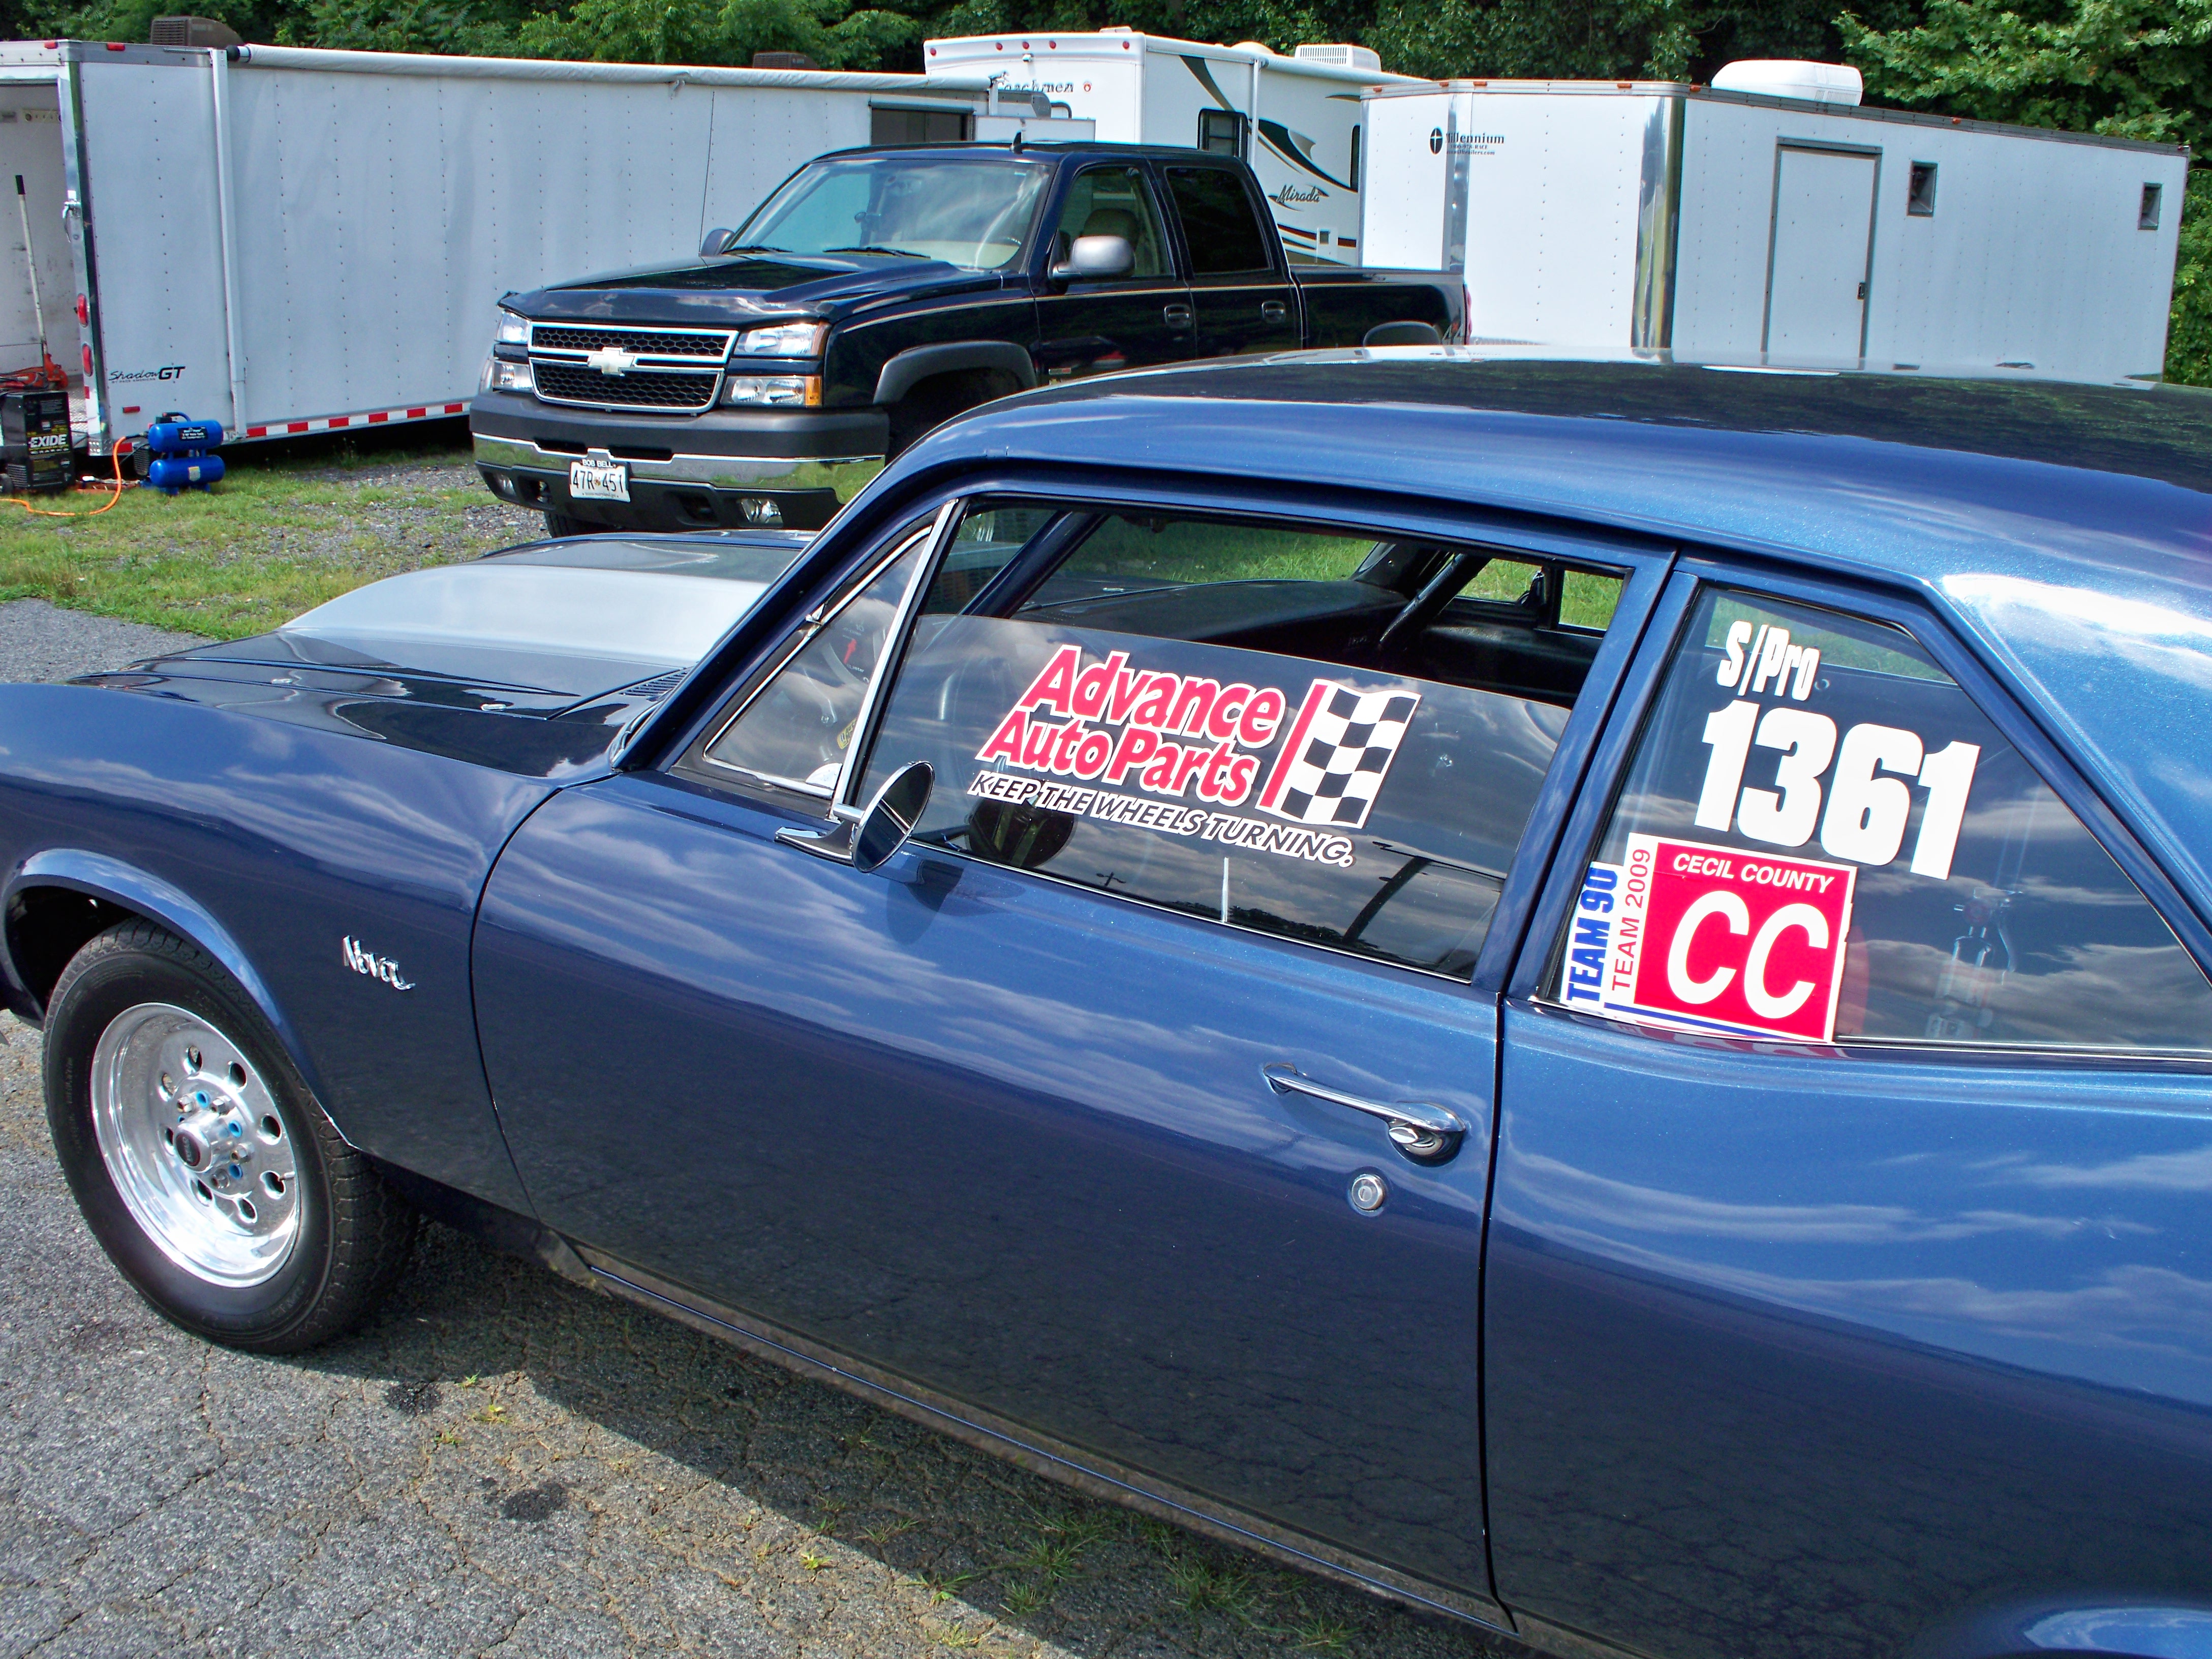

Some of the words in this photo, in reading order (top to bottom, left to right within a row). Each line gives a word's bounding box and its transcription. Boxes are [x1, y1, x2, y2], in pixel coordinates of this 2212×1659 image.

[1276, 185, 1320, 203] Mirada
[108, 370, 160, 381] Shadow
[159, 365, 186, 380] GT
[29, 434, 68, 448] EXIDE
[596, 459, 613, 468] BELL
[573, 470, 595, 489] 47R
[602, 473, 624, 493] 451
[1716, 621, 1821, 700] S/Pro
[1016, 644, 1285, 748] Advance
[975, 709, 1114, 780] Auto
[1101, 723, 1261, 807] Parts
[967, 770, 1038, 804] KEEP
[1037, 785, 1098, 813] THE
[1090, 792, 1206, 836] WHEELS
[1202, 818, 1354, 867] TURNING.
[1695, 699, 1981, 880] 1361
[1580, 867, 1619, 913] 90
[1625, 849, 1651, 909] 2009
[1673, 852, 1735, 879] CECIL
[1740, 863, 1834, 894] COUNTY
[343, 935, 416, 990] Nova
[1566, 913, 1610, 1003] TEAM
[1611, 916, 1641, 992] TEAM
[1667, 890, 1830, 1019] CC
